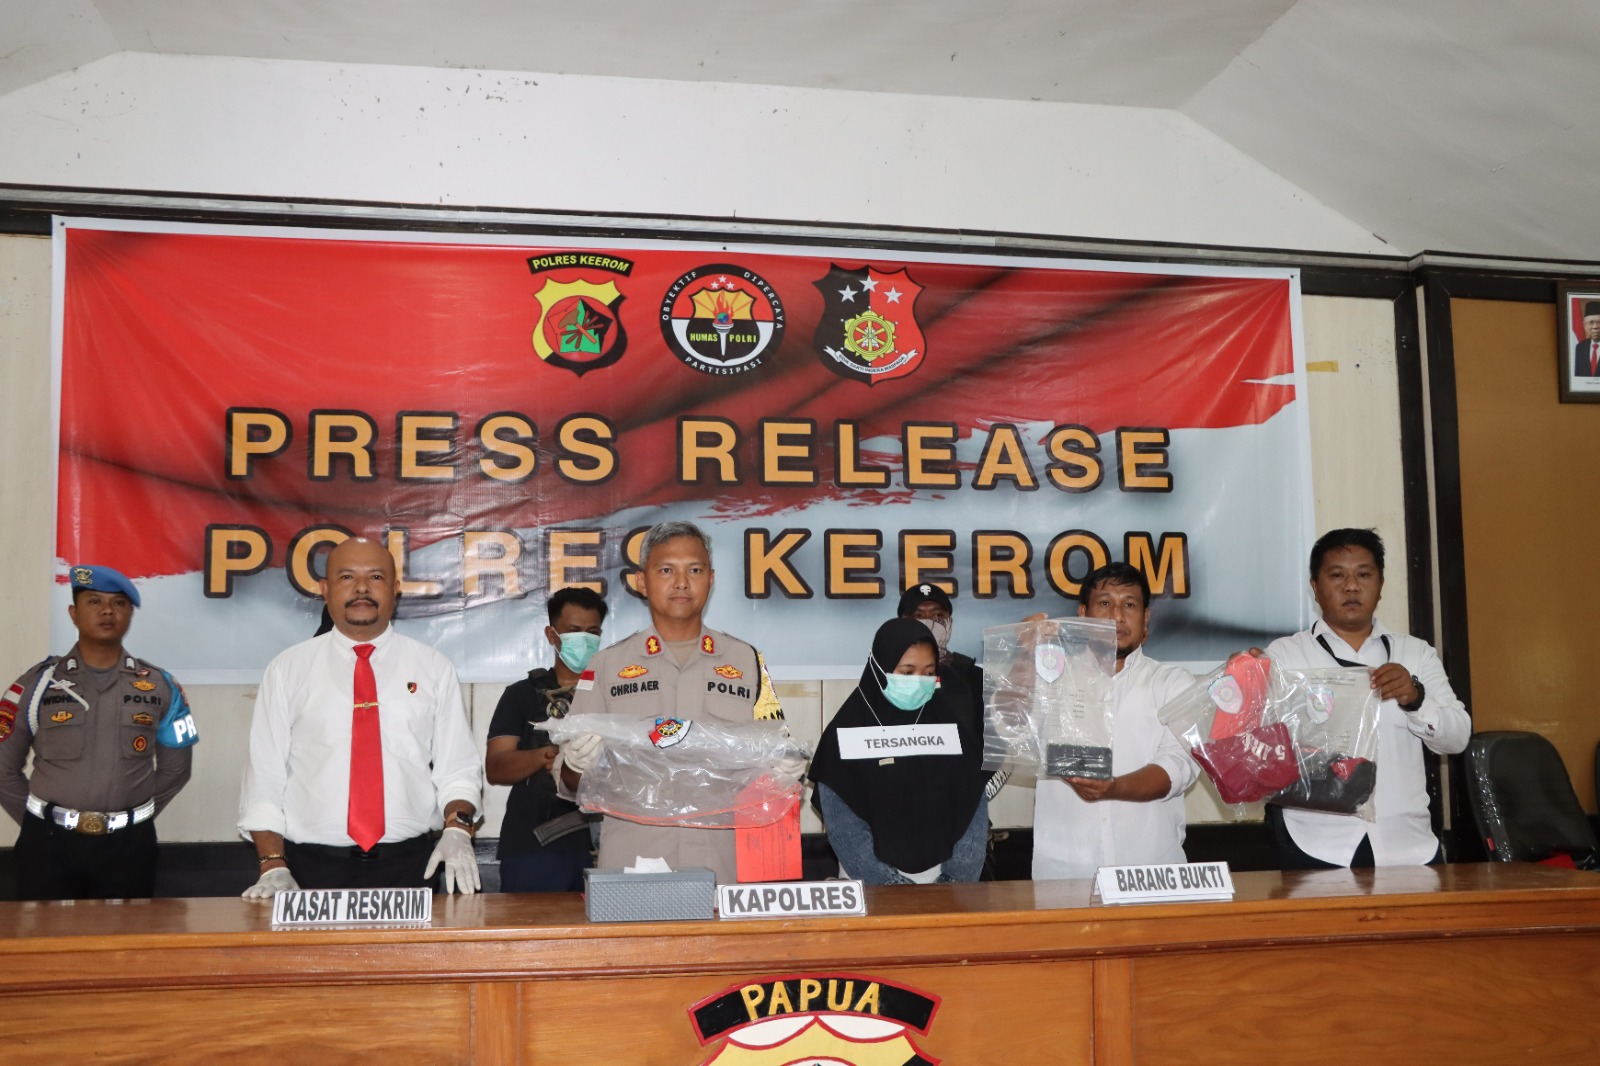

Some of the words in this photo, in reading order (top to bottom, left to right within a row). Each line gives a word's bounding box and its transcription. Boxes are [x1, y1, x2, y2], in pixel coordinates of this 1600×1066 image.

[532, 255, 577, 269] POLRES
[580, 254, 630, 272] KEEROM
[662, 271, 698, 320] OBYEKTIF
[743, 271, 783, 329] DIPERCAYA
[689, 332, 718, 342] HUMAS
[729, 333, 757, 343] POLRI
[684, 356, 763, 375] PARTISIPASI
[225, 407, 619, 484] PRESS
[676, 415, 1173, 493] RELEASE
[744, 528, 1191, 599] KEEROM
[123, 694, 162, 706] POLRI
[610, 681, 638, 697] CHRIS
[640, 680, 659, 692] AER
[707, 681, 750, 699] POLRI
[864, 735, 945, 749] TERSANGKA
[1115, 867, 1177, 892] BARANG
[1178, 865, 1225, 889] BUKTI
[282, 891, 342, 922] KASAT
[346, 890, 425, 920] RESKRIM
[728, 885, 857, 914] KAPOLRES
[740, 978, 880, 1022] PAPUA
